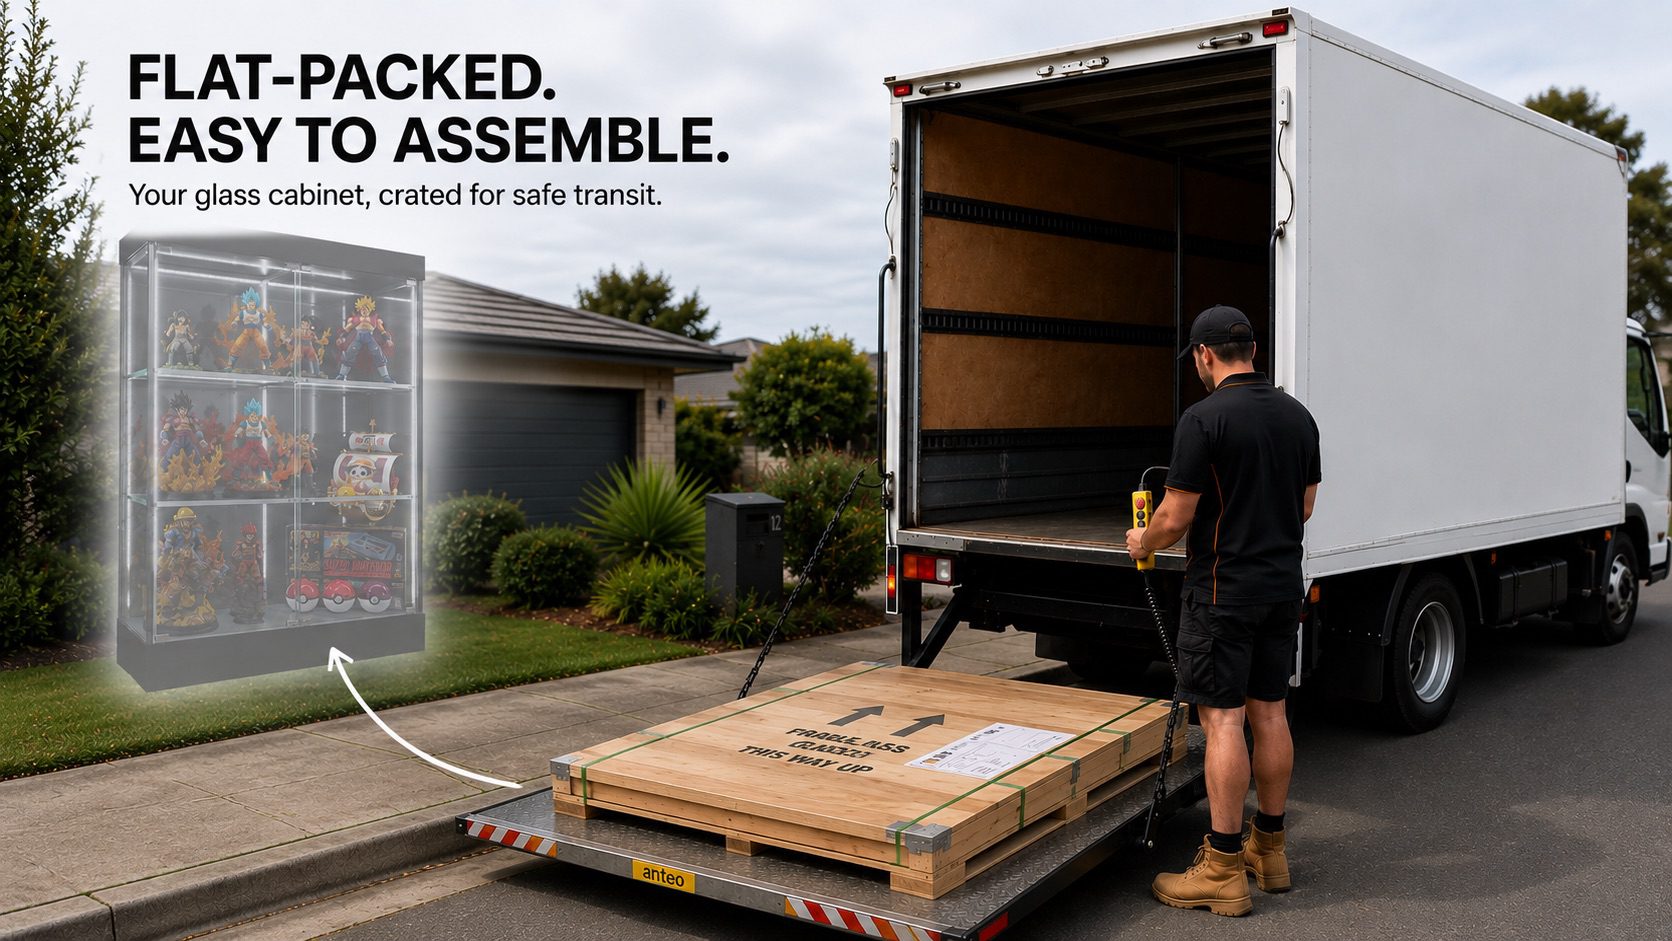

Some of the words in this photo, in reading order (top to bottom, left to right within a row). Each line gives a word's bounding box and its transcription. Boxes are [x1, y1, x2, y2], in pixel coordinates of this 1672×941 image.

[771, 514, 782, 531] 12
[738, 745, 790, 760] THIS
[786, 754, 838, 768] WAY
[836, 763, 874, 774] UP
[642, 867, 685, 887] anteo
